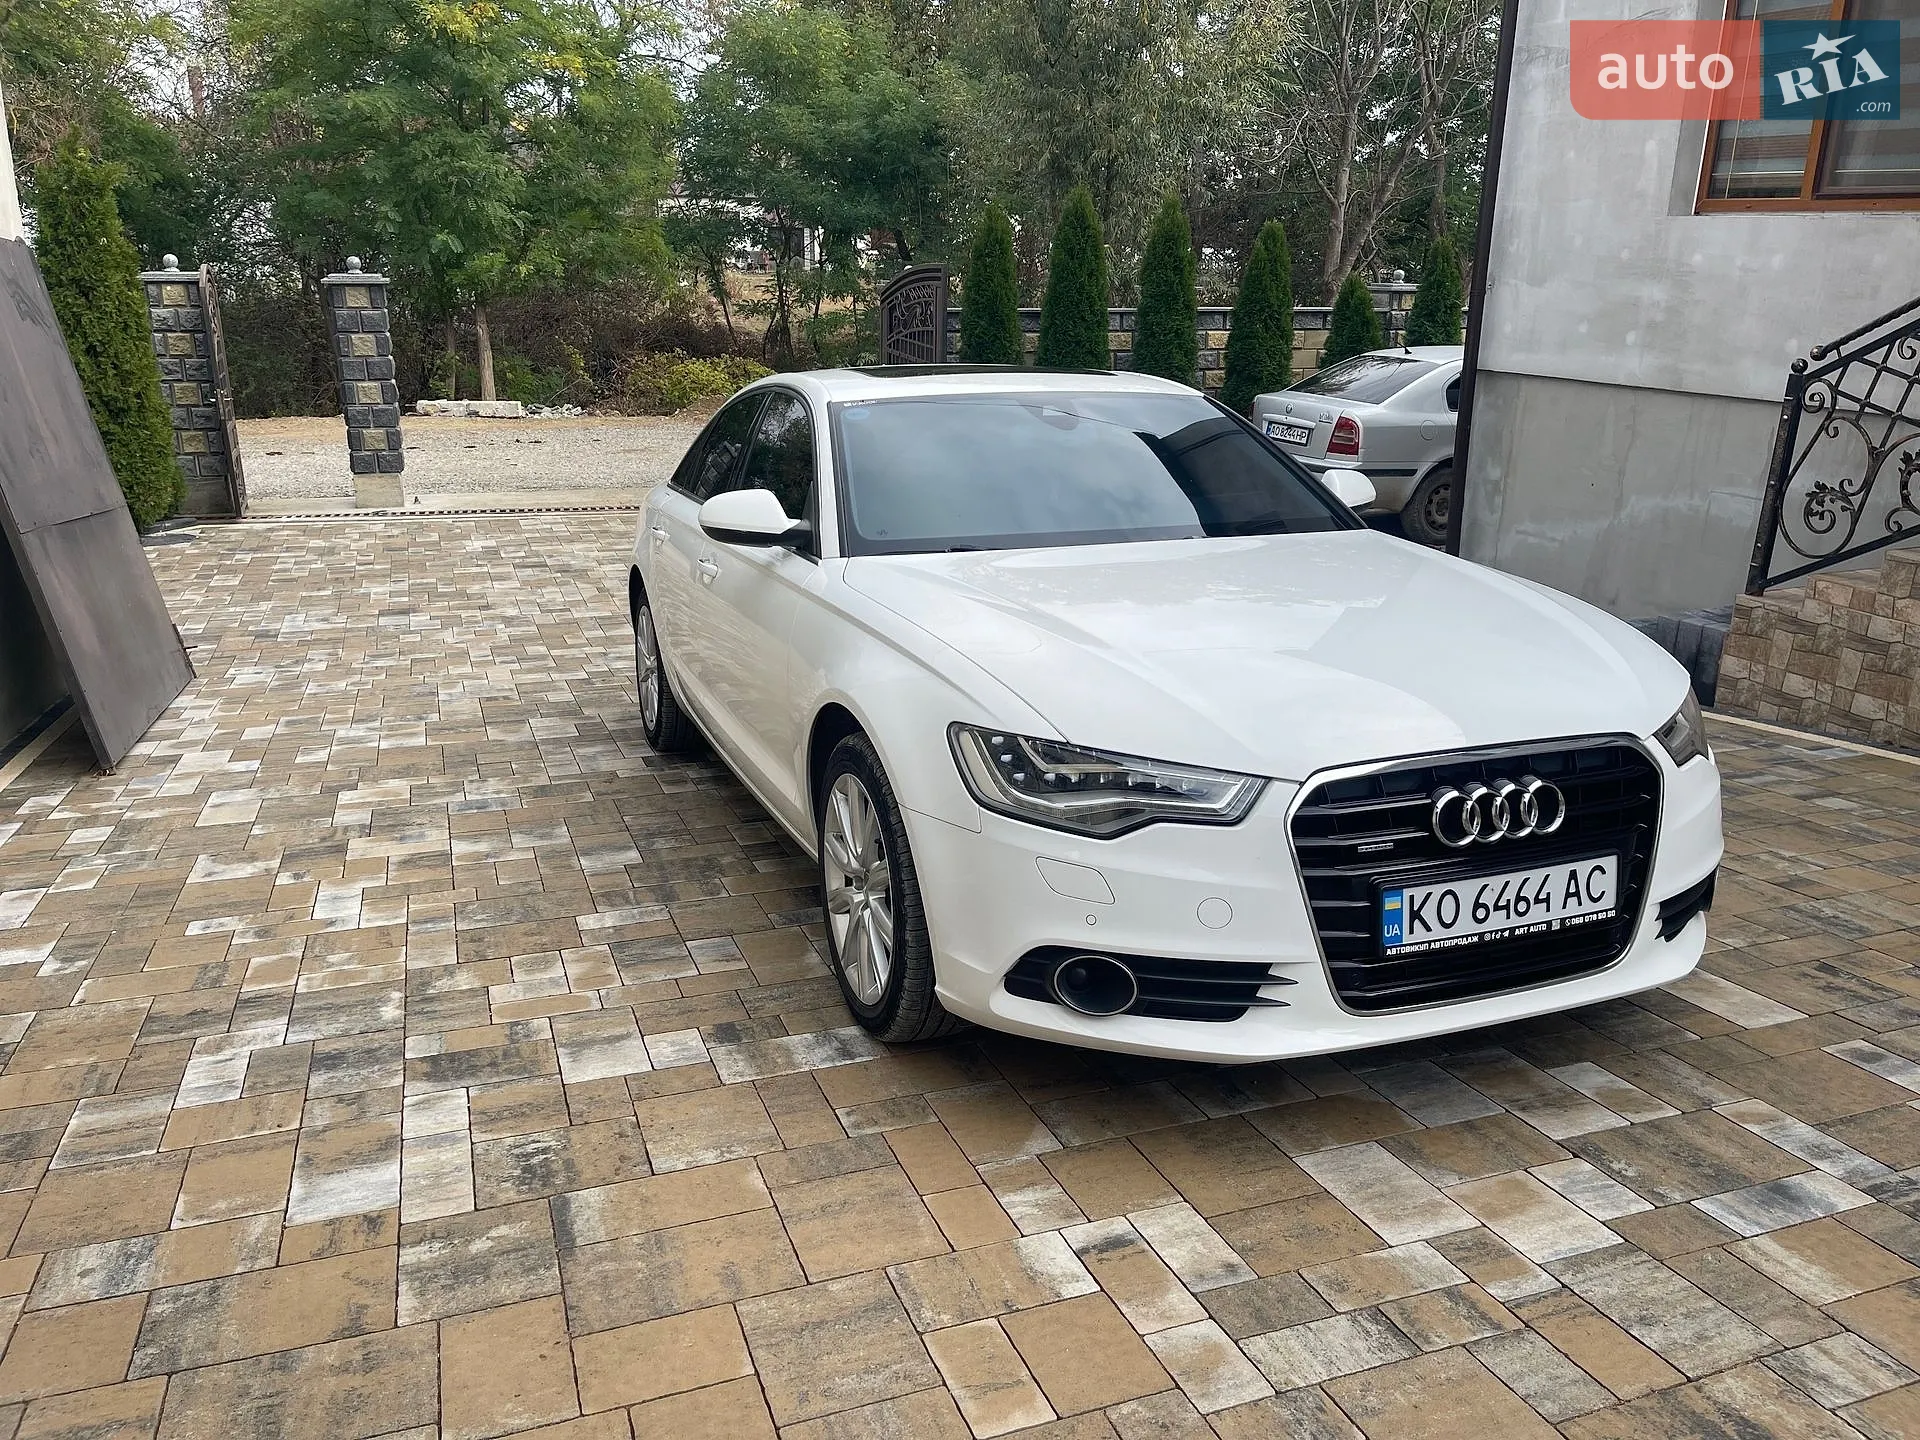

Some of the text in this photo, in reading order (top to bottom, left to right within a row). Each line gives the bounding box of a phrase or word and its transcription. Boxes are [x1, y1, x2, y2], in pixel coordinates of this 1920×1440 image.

[1408, 864, 1607, 935] KO 6464 AC
[1384, 924, 1400, 938] UA
[1514, 923, 1547, 936] ART AUTO
